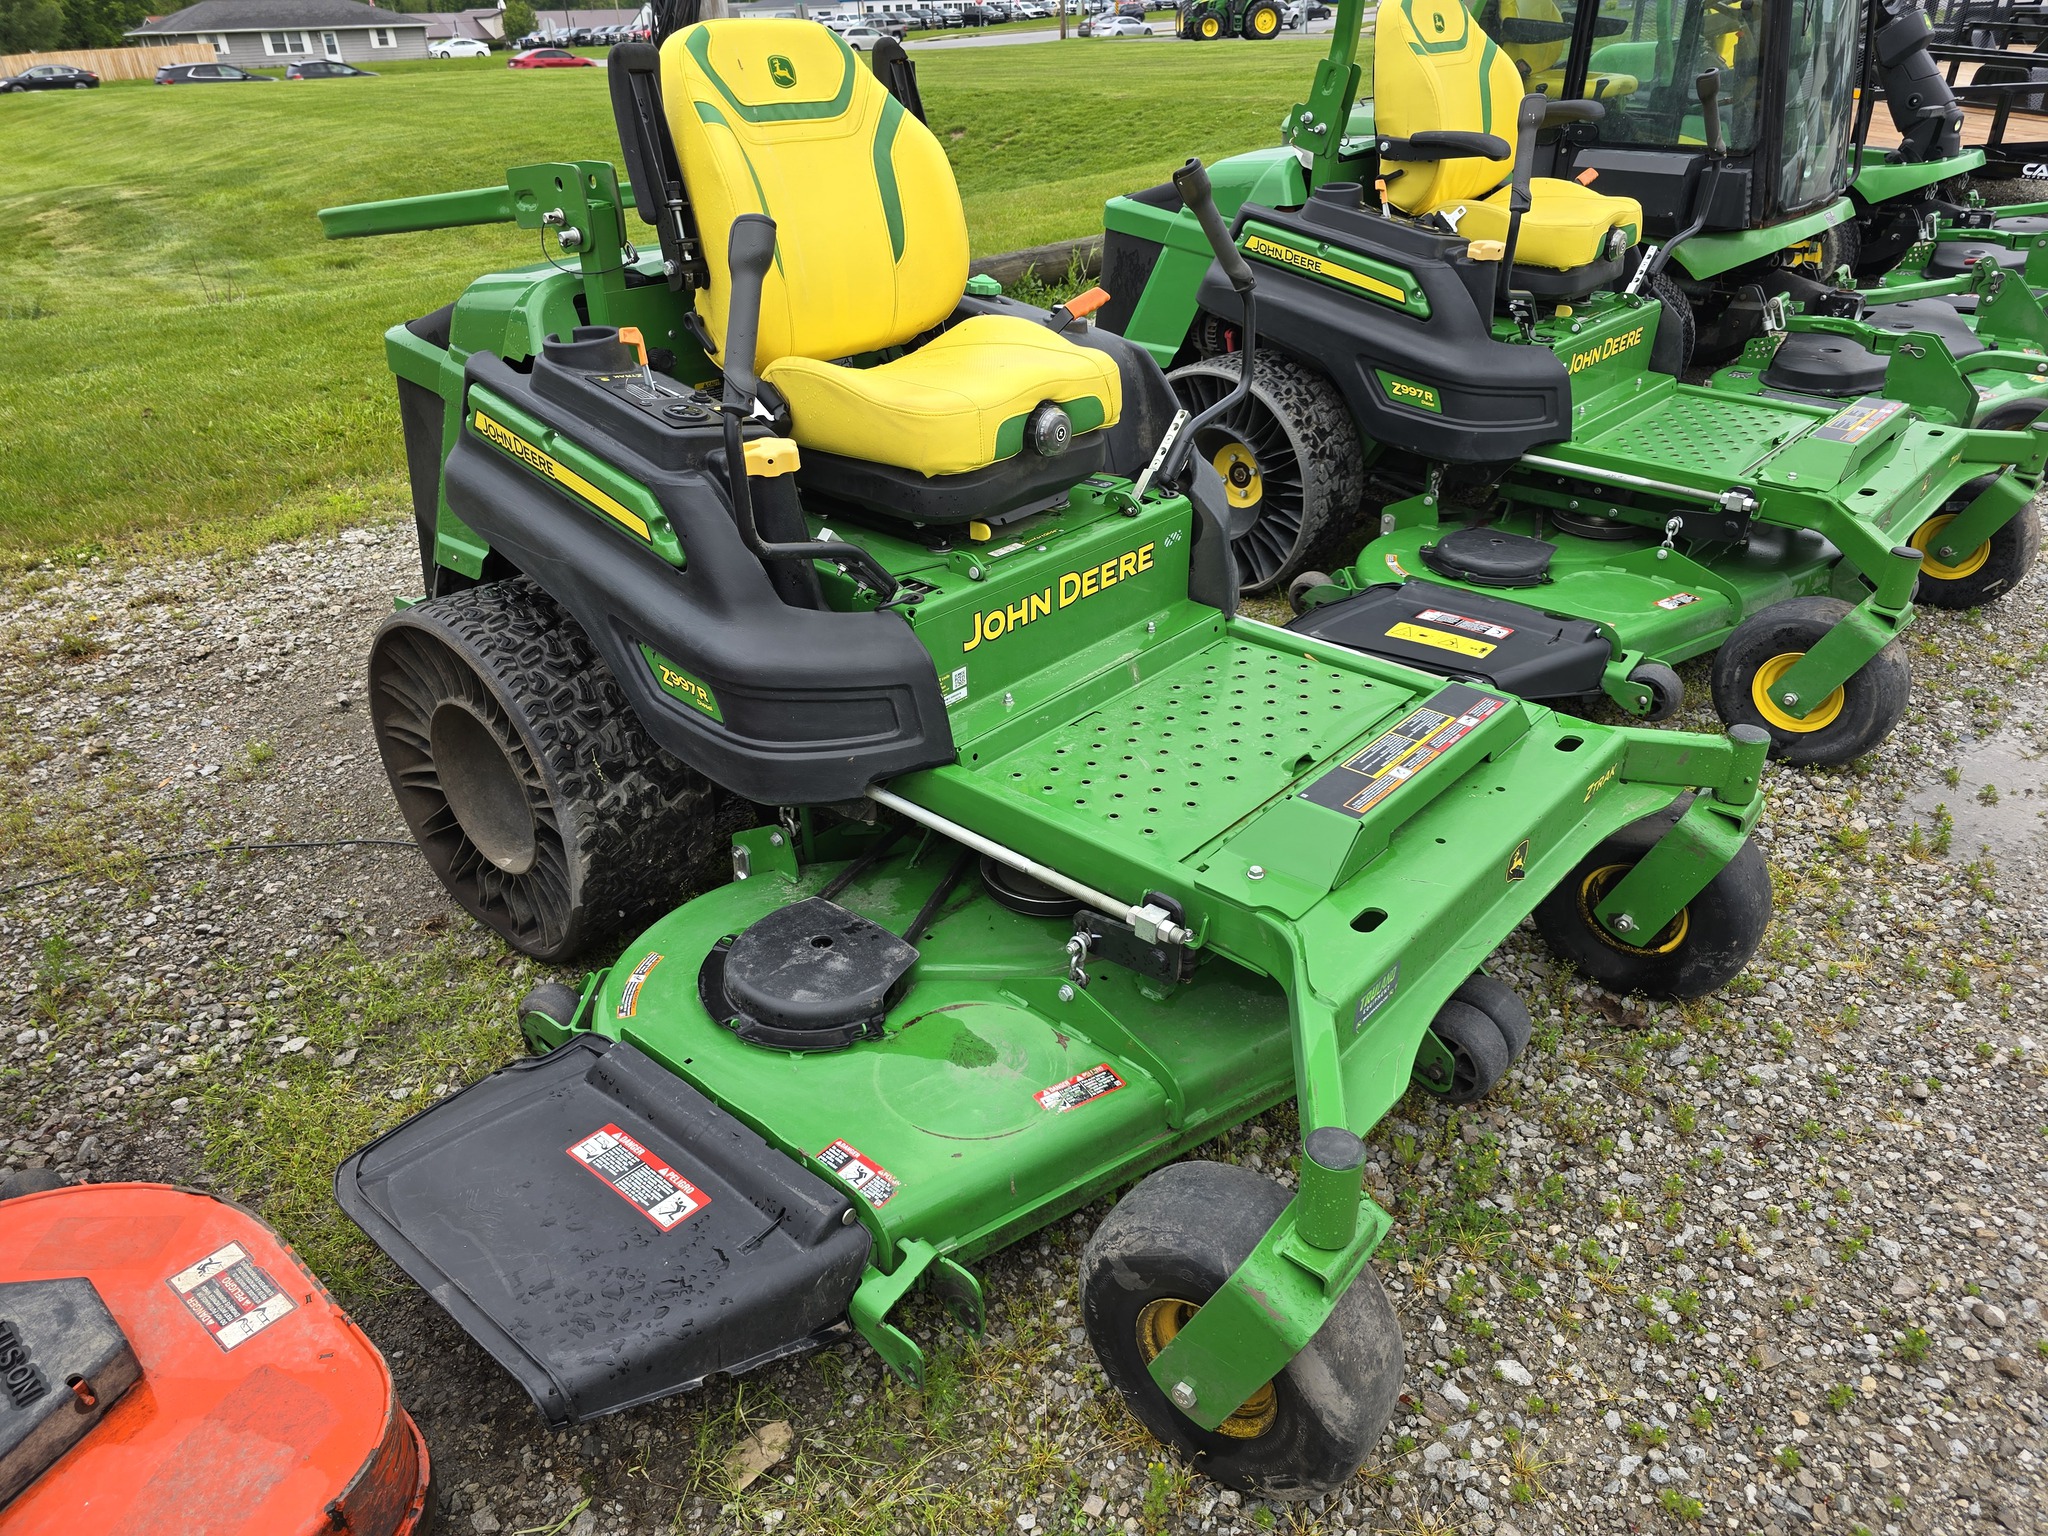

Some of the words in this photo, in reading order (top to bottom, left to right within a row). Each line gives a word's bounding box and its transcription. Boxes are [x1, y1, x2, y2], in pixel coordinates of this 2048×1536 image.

[1253, 240, 1283, 259] JOHN
[1284, 249, 1322, 272] DEERE
[1568, 345, 1602, 375] JOHN
[1602, 327, 1644, 360] DEERE
[1391, 381, 1434, 402] Z997R
[483, 418, 514, 452] JOHN
[513, 436, 556, 479] DEERE
[963, 586, 1051, 653] JOHN
[1058, 541, 1155, 609] DEERE
[658, 664, 709, 703] Z997R
[1583, 763, 1618, 803] ZTRAK
[1048, 1080, 1071, 1093] DANGER
[619, 1132, 646, 1156] DANGER
[840, 1141, 861, 1159] DANGER
[666, 1170, 695, 1195] PELIGRO
[221, 1276, 247, 1304] PELIGRO
[186, 1296, 210, 1322] DANGER
